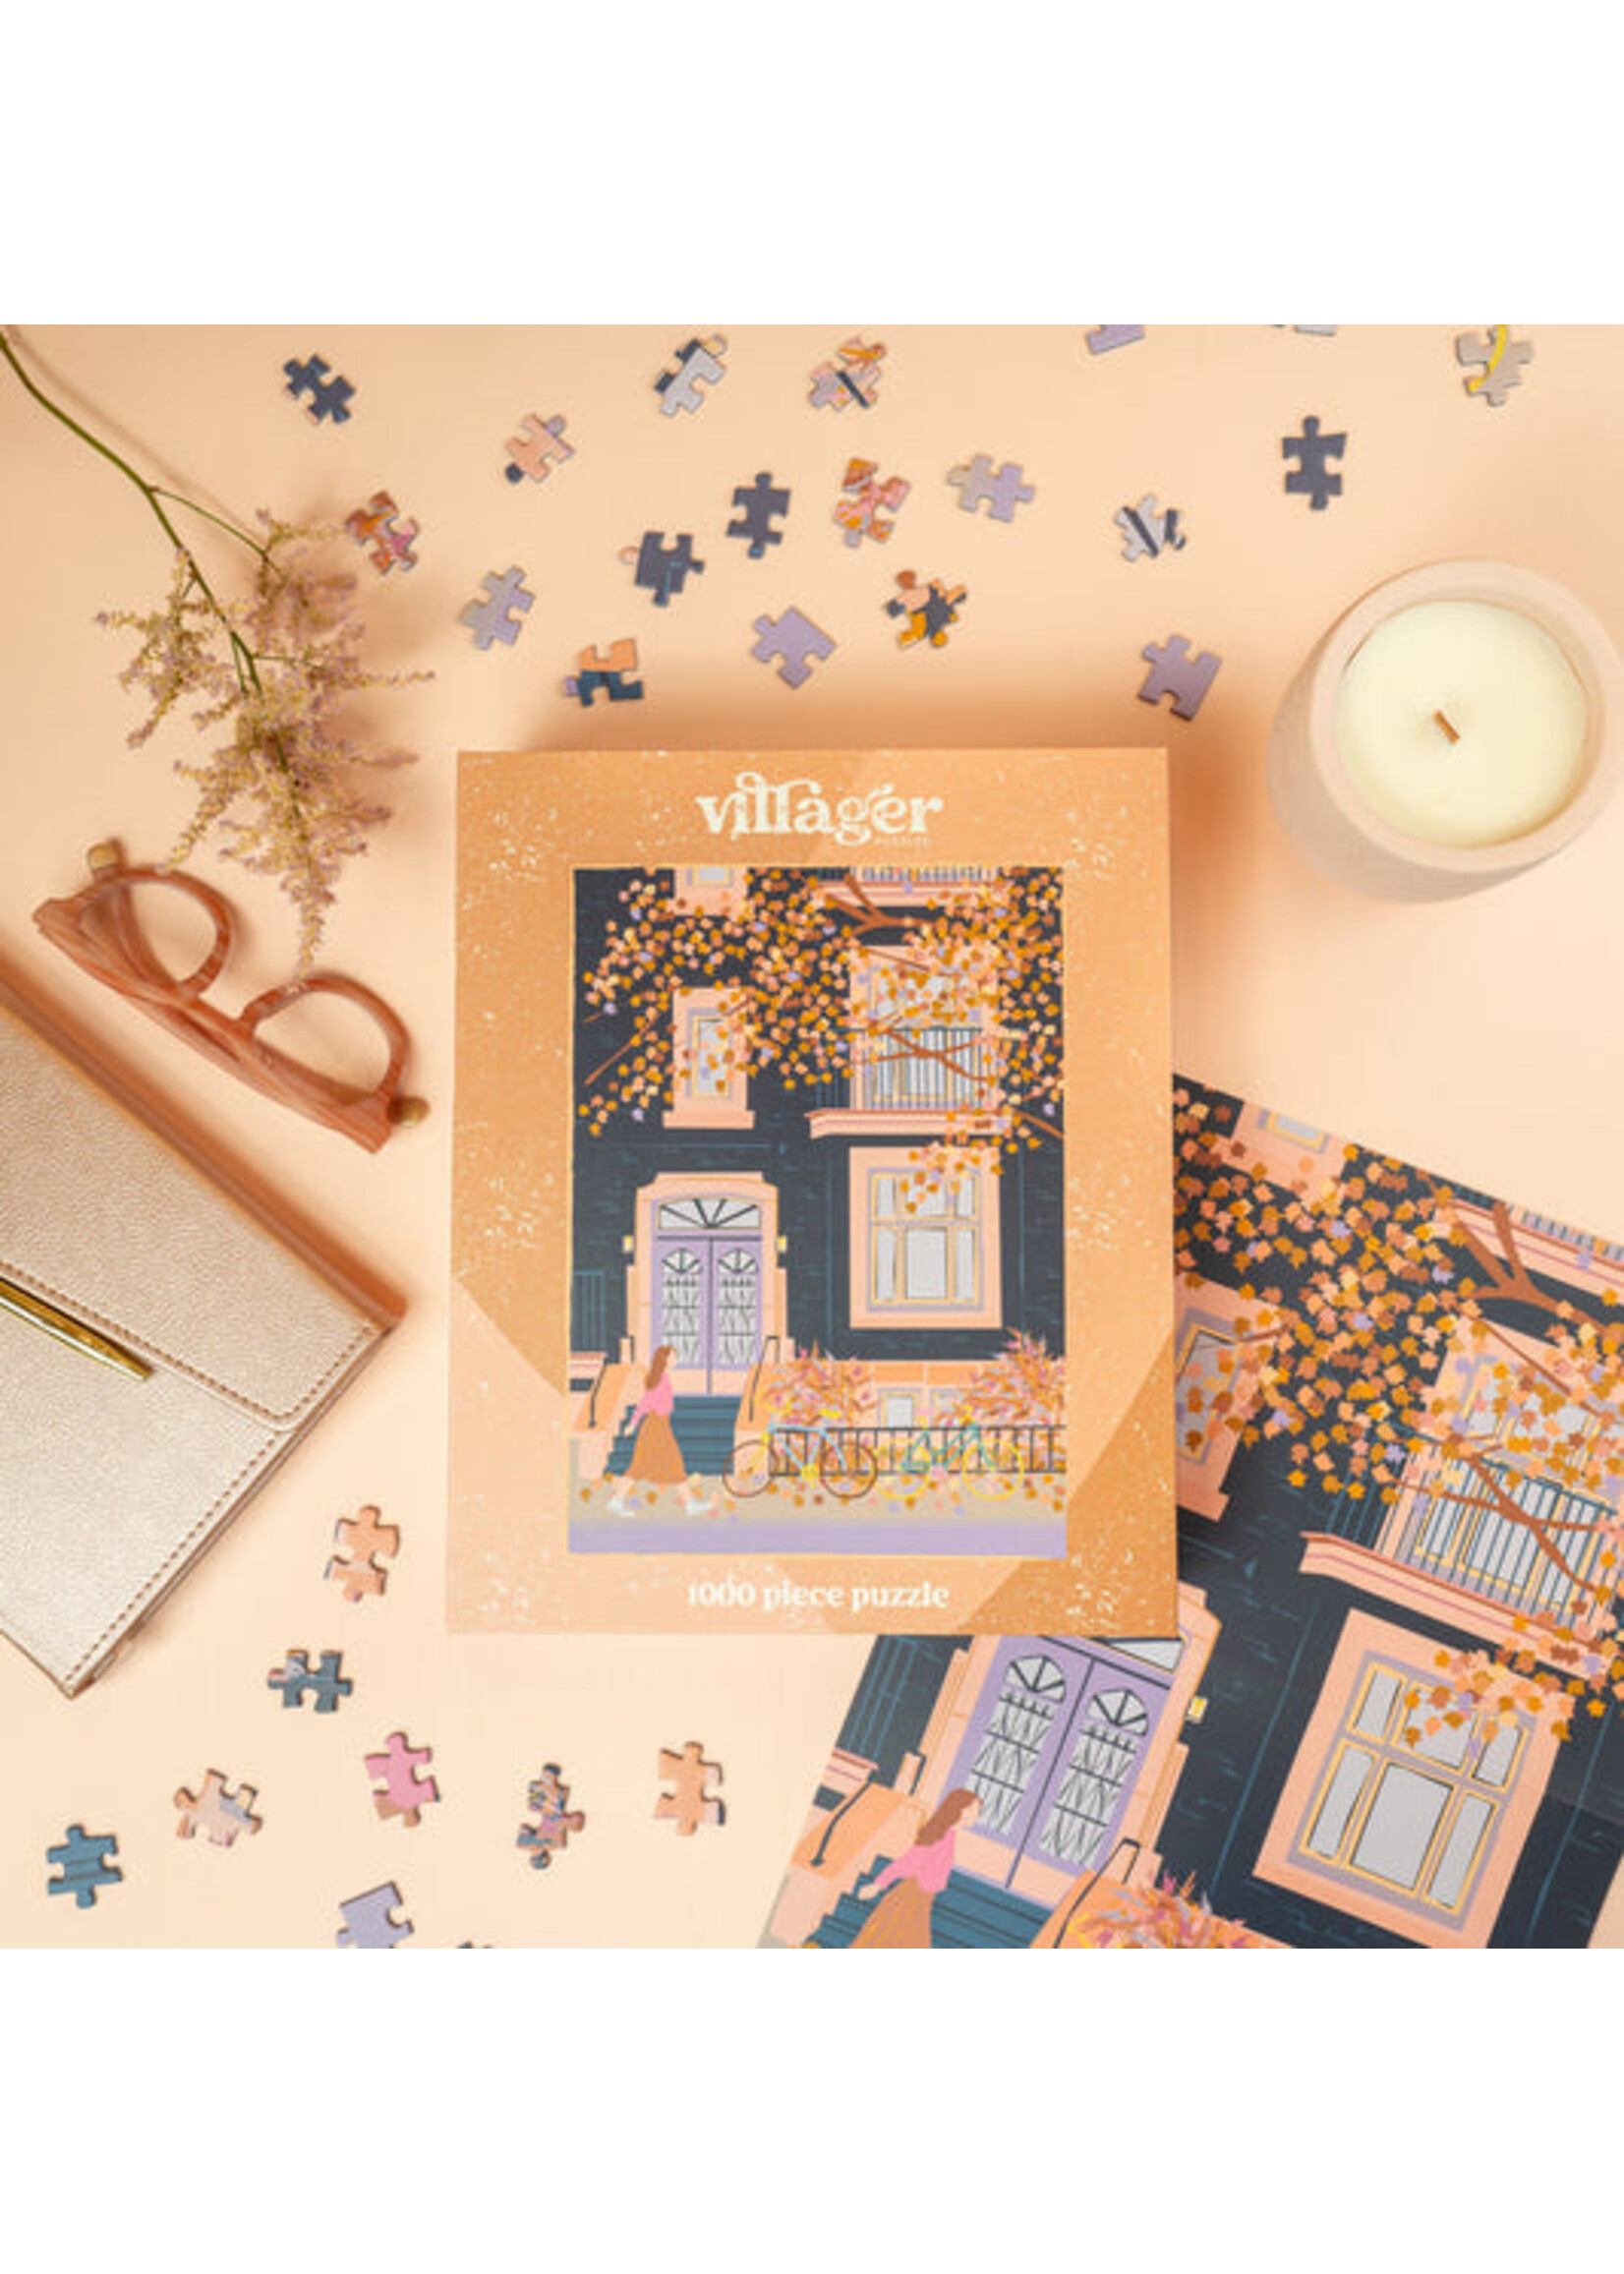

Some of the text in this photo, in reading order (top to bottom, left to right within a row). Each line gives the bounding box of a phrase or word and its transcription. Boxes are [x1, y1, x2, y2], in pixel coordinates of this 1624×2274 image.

[695, 771, 944, 845] villager
[688, 1578, 950, 1611] 1000 piece puzzle
